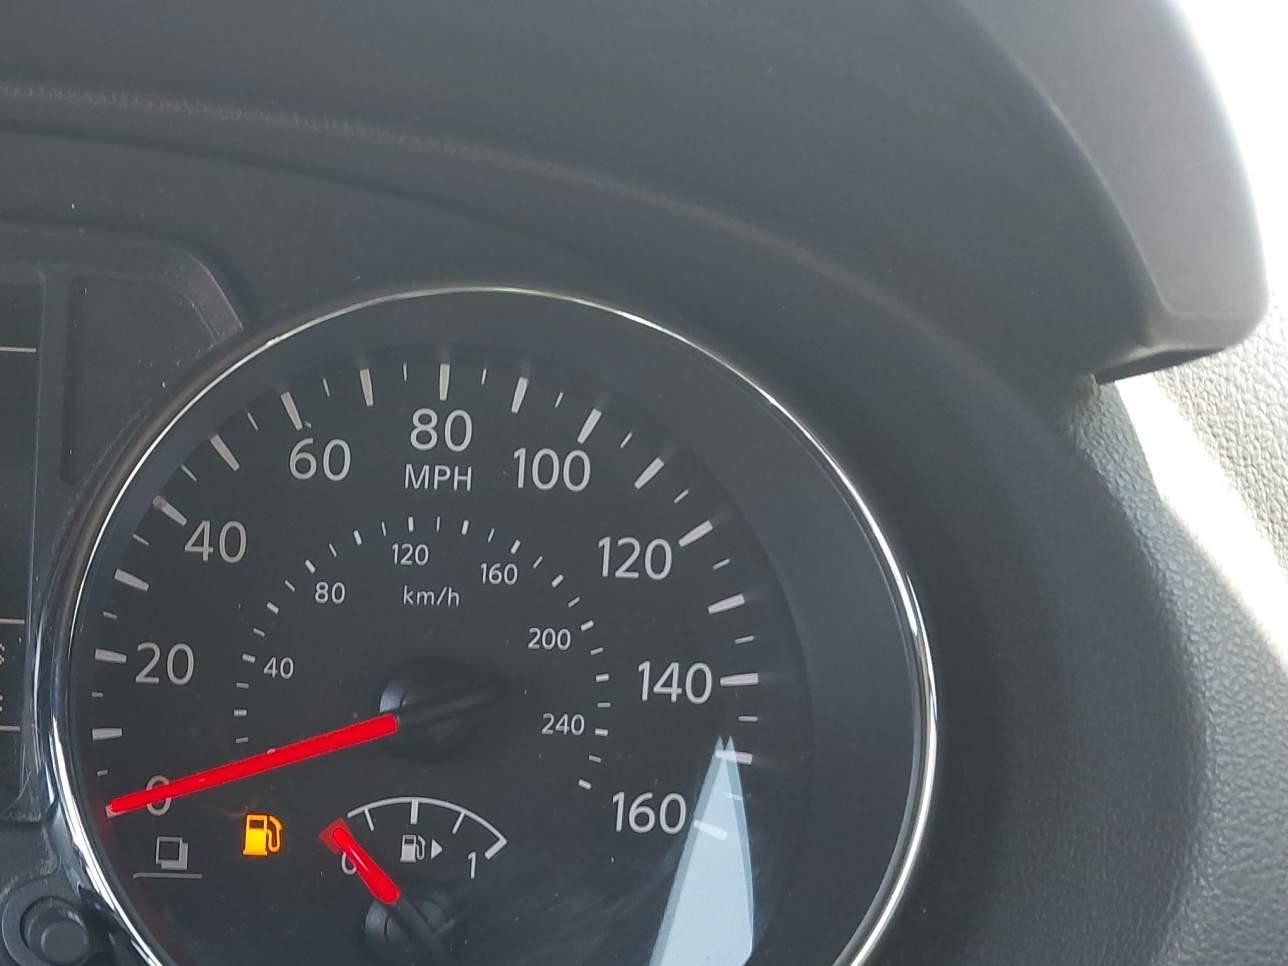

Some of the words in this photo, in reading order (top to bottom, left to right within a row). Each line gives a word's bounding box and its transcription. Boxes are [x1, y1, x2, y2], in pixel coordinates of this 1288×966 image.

[410, 408, 473, 452] 80
[289, 438, 351, 481] 60
[513, 447, 591, 492] 100
[404, 463, 472, 491] MPH
[184, 519, 247, 563] 40
[392, 543, 429, 566] 120
[598, 536, 672, 580] 120
[480, 563, 518, 585] 160
[314, 581, 346, 604] 80
[403, 585, 460, 606] km/h
[527, 627, 571, 651] 200
[135, 642, 195, 685] 20
[263, 657, 294, 679] 40
[638, 660, 713, 704] 140
[541, 713, 585, 736] 240
[612, 791, 687, 834] 160
[467, 851, 477, 879] 1
